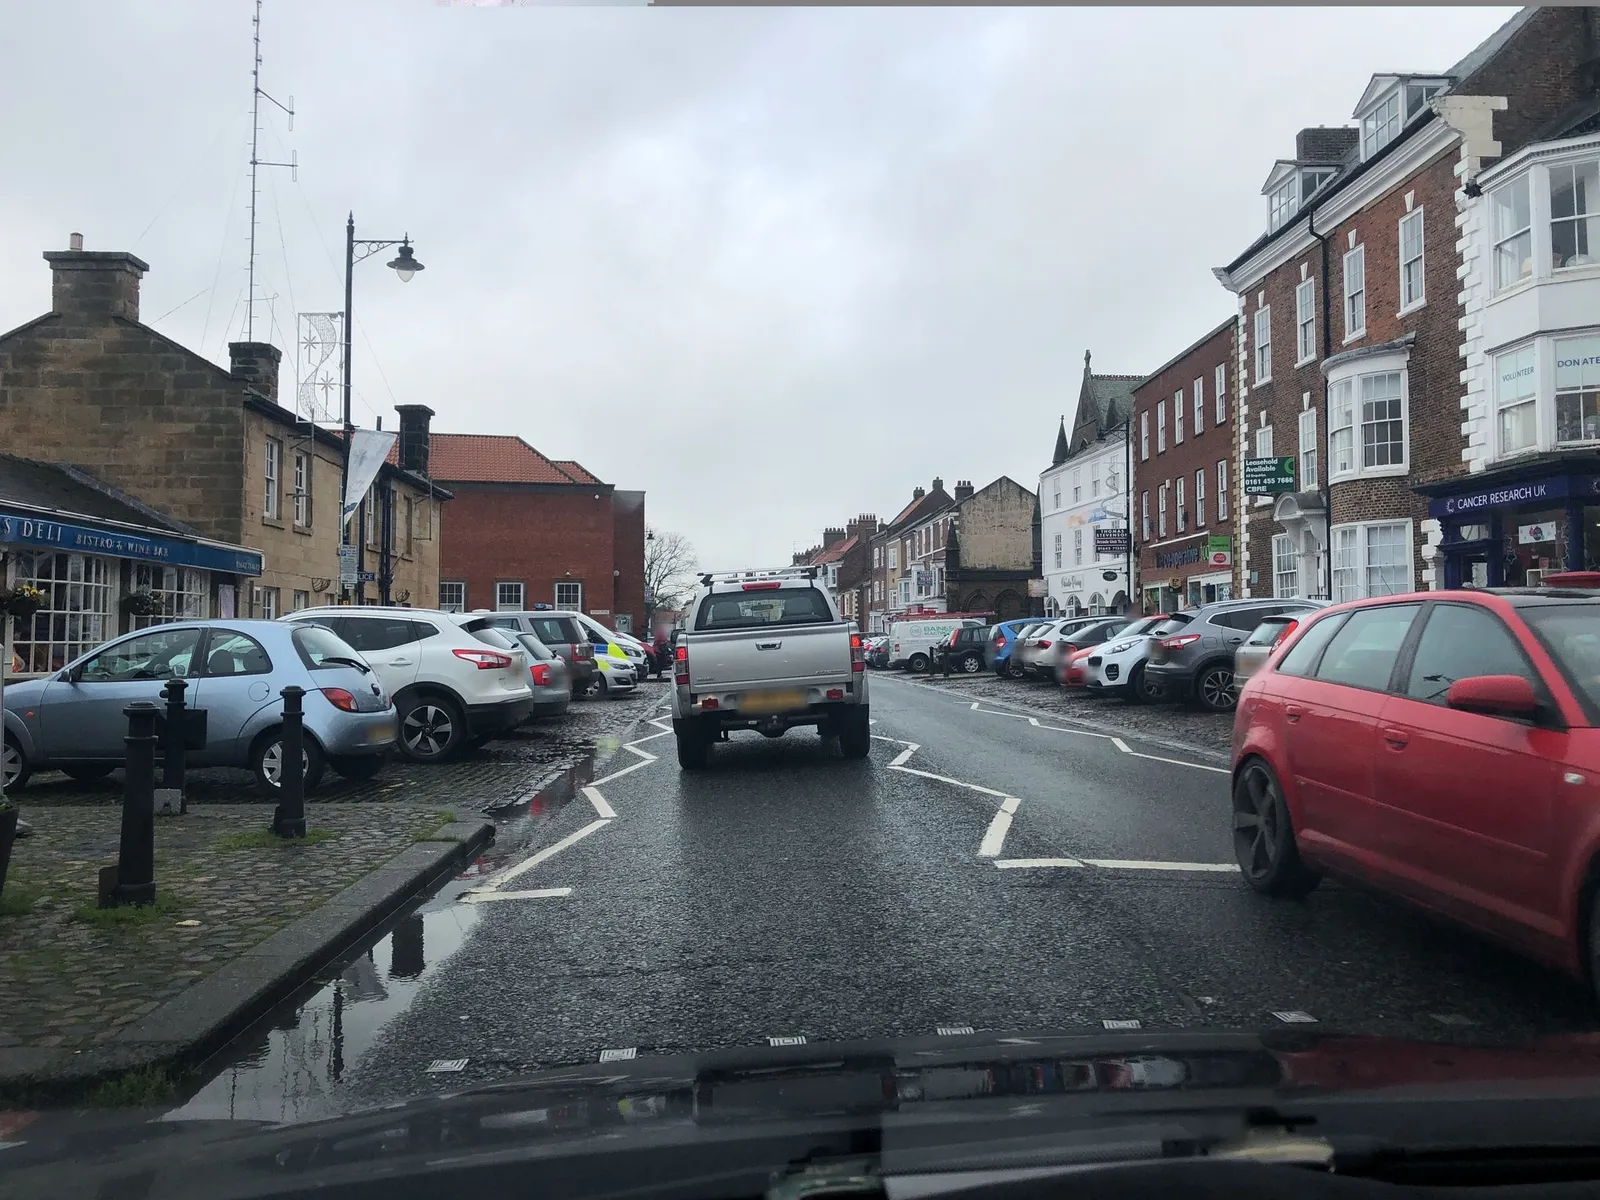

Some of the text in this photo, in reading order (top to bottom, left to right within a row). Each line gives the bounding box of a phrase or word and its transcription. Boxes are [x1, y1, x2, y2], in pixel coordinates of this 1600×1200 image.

[1502, 366, 1535, 382] VOLUNTEER
[1245, 458, 1278, 466] Leasehold
[1246, 465, 1276, 473] Available
[1457, 484, 1546, 510] CANCER RESEARCH UK
[22, 520, 62, 542] DELI
[75, 534, 113, 549] BISTRO
[127, 542, 149, 554] WINE
[153, 546, 168, 557] BAR
[1200, 541, 1209, 560] fo
